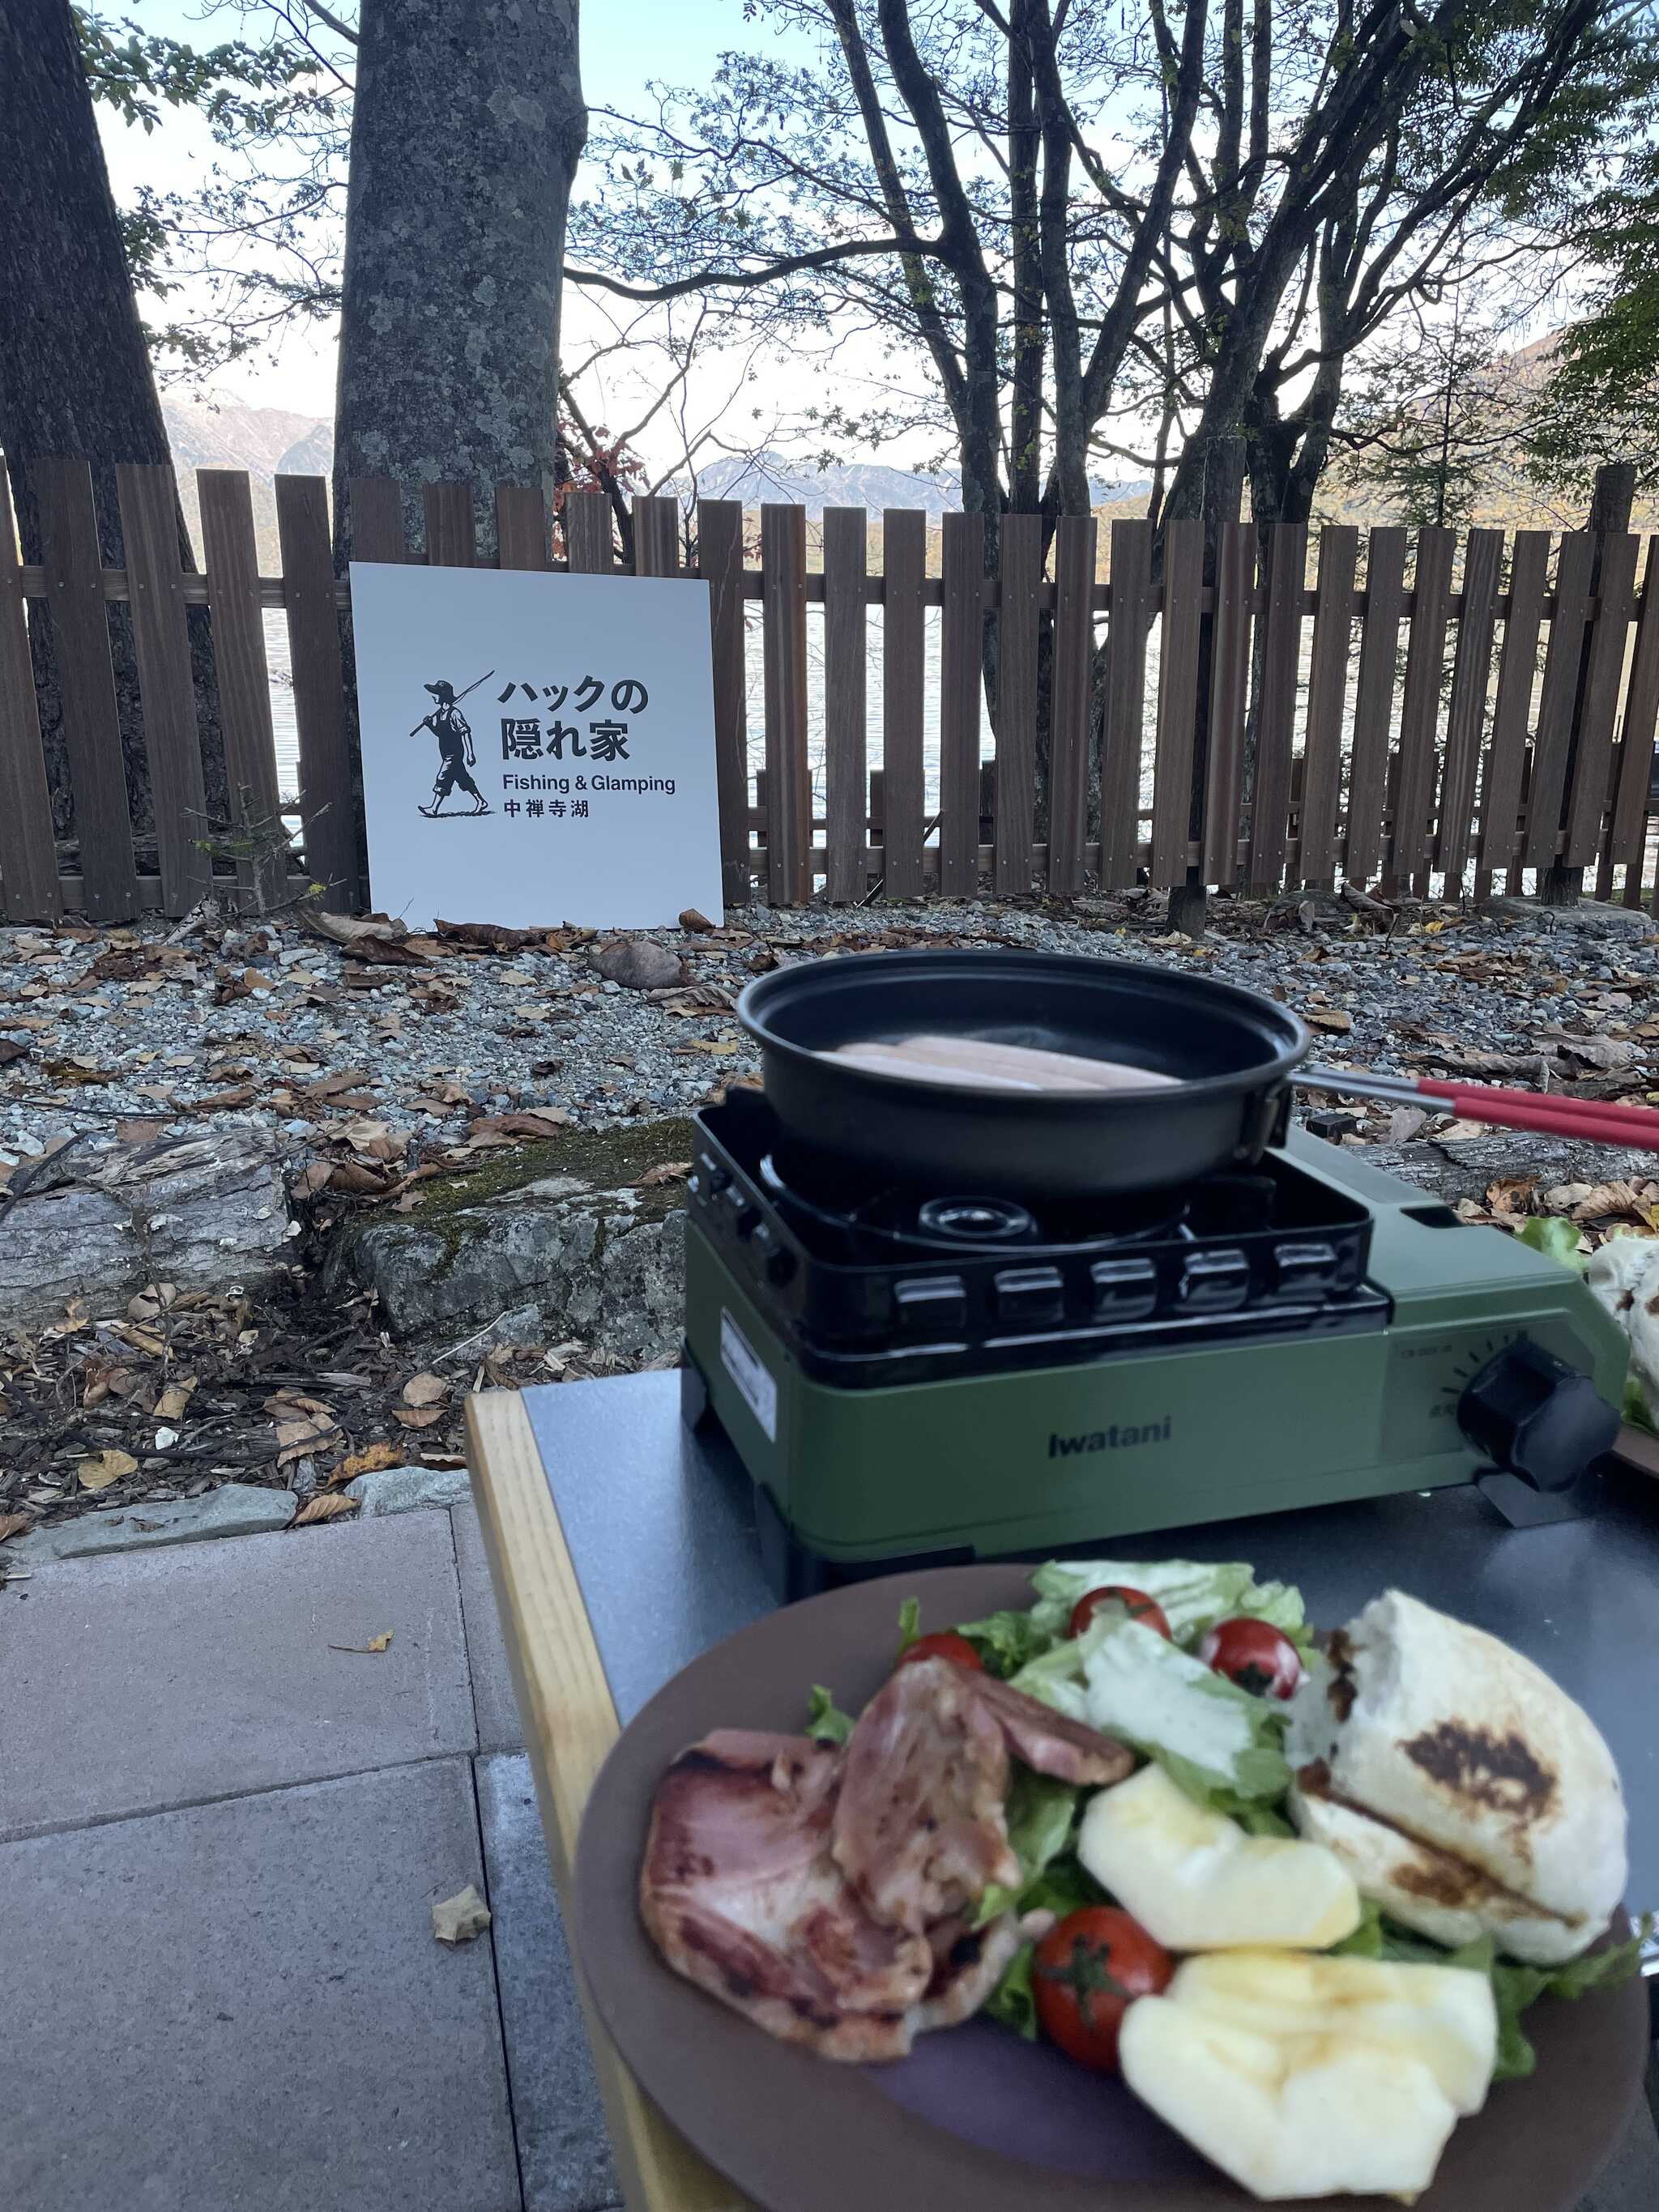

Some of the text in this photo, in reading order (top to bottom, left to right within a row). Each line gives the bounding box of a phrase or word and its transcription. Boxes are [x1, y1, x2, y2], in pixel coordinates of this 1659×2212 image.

[498, 675, 649, 714] ハックの
[501, 718, 630, 761] 隠れ家
[503, 774, 676, 795] Fishing & Glamping
[504, 799, 589, 818] 中禅寺湖
[1049, 1416, 1171, 1458] Iwatani
